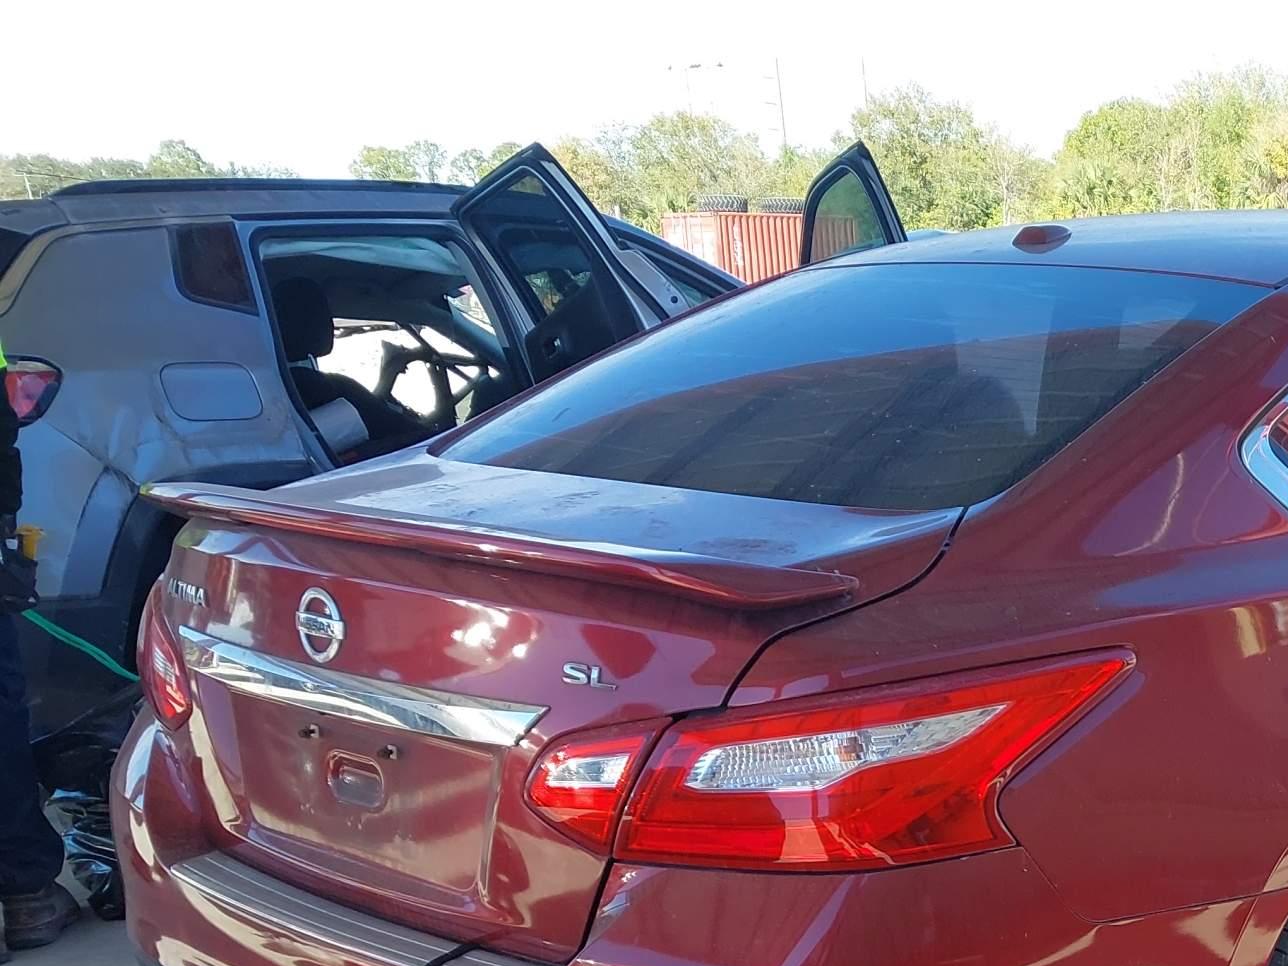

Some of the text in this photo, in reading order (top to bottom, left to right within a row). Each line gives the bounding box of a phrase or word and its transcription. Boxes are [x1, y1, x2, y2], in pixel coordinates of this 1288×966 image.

[168, 577, 208, 608] ALTIMA
[298, 614, 337, 637] NISSAN
[562, 661, 617, 690] SL
